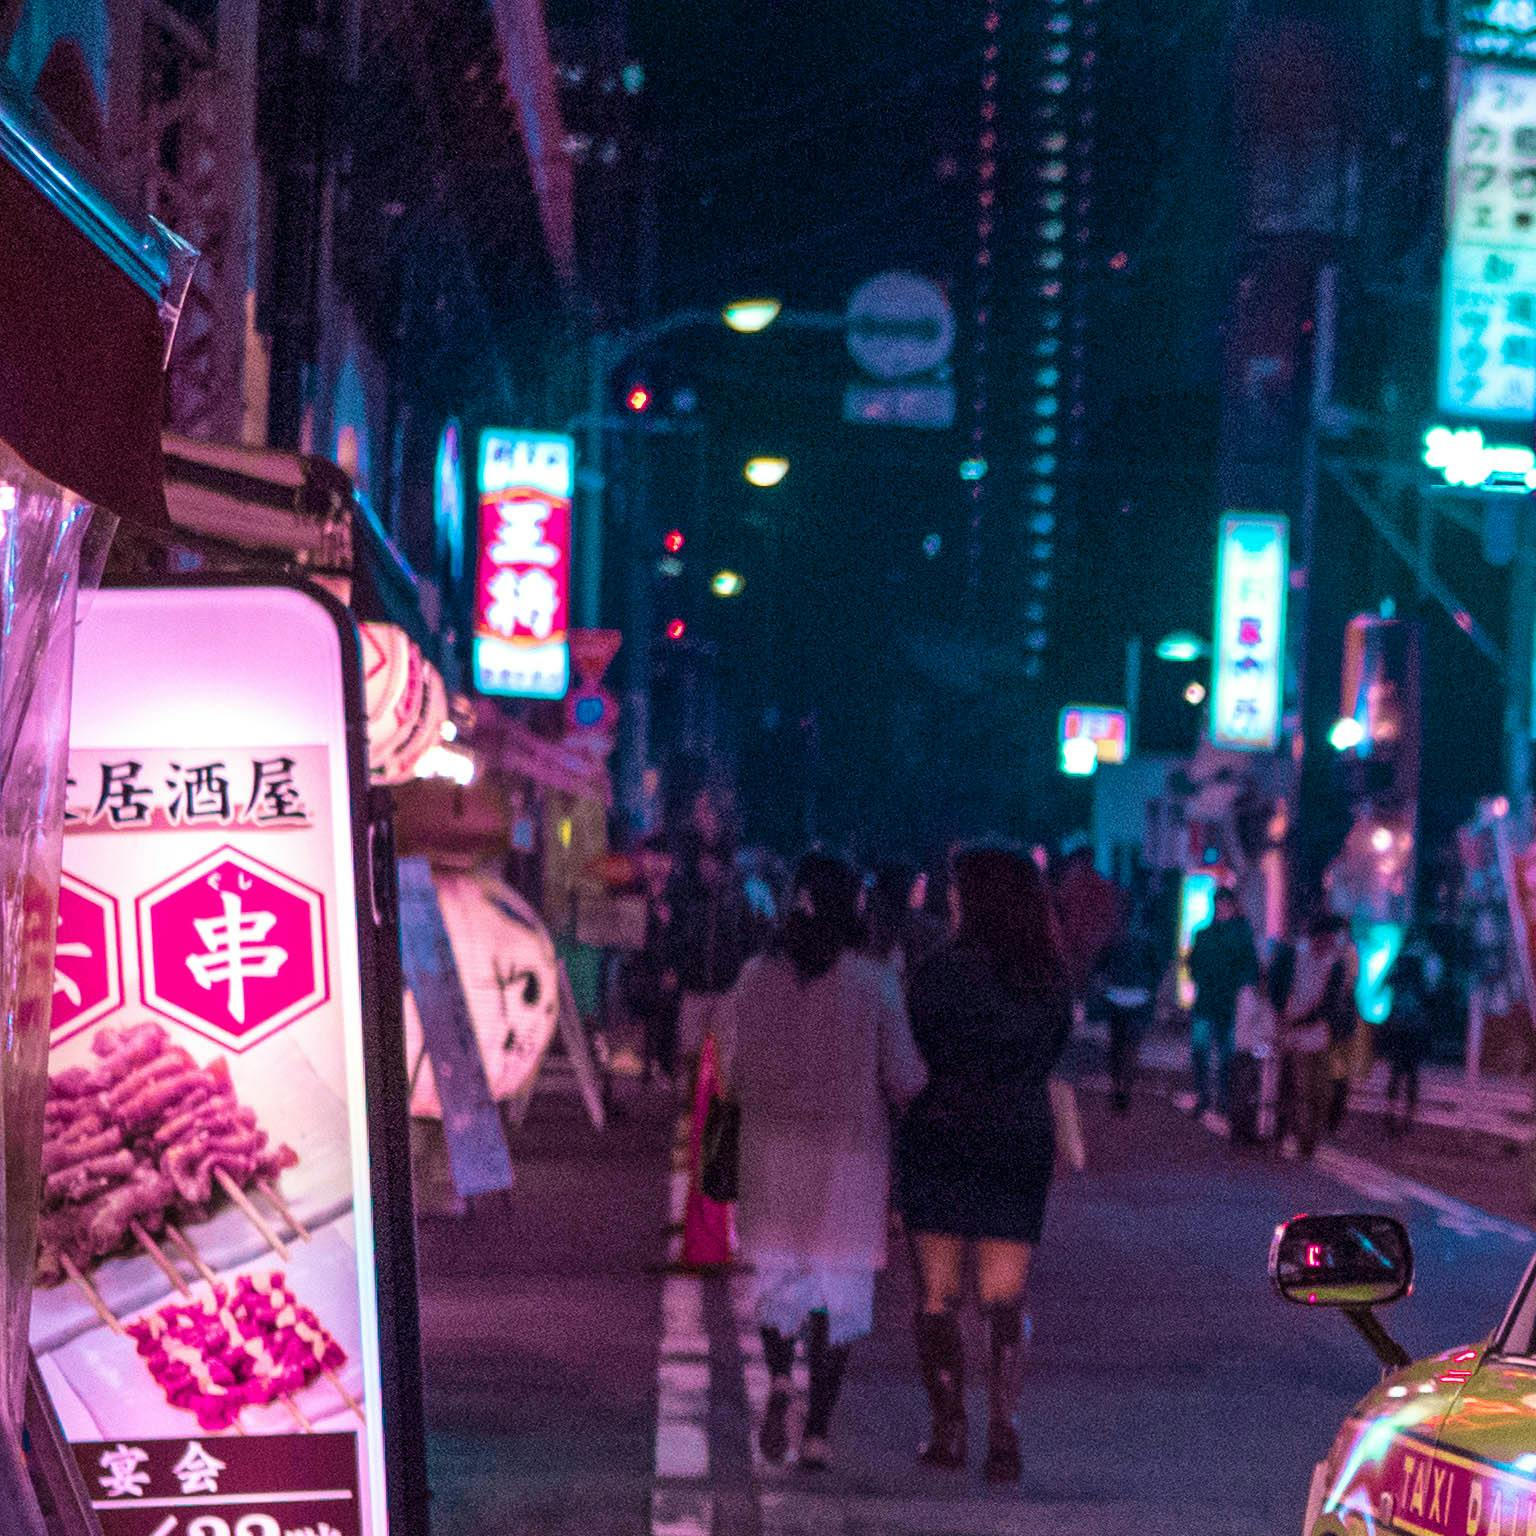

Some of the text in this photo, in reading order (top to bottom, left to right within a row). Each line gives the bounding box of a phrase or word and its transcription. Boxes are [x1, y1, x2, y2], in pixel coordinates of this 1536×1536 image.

[65, 756, 307, 824] 居酒屋
[185, 890, 289, 1024] 串
[98, 1440, 227, 1497] 宴会
[1404, 1455, 1455, 1528] TAXI
